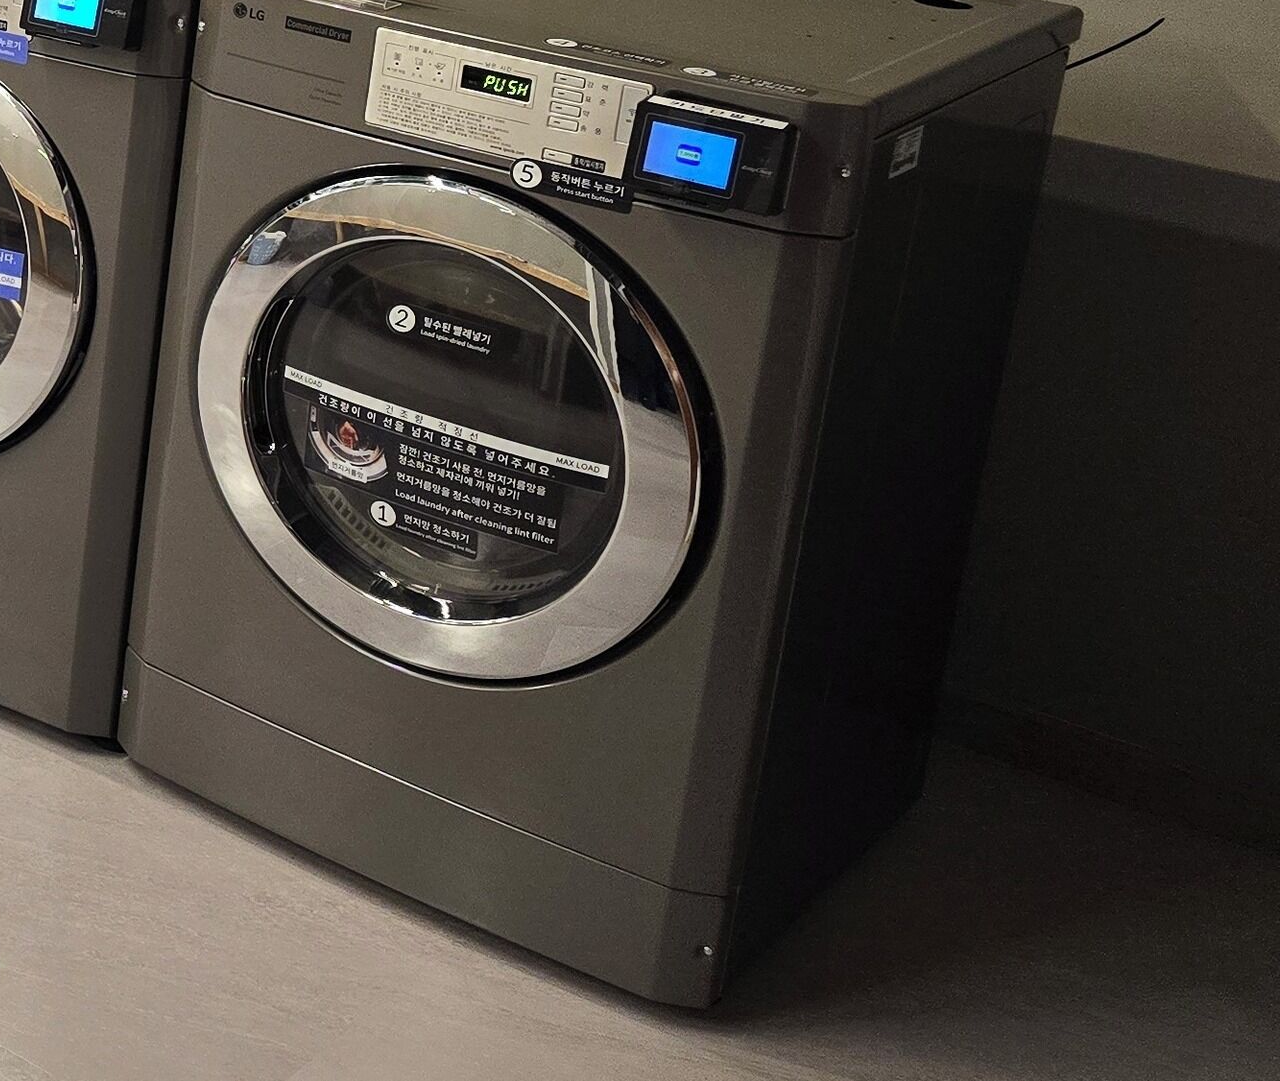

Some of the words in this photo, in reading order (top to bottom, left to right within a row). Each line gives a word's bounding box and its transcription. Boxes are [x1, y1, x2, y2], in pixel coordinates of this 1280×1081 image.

[249, 7, 265, 21] LG
[287, 19, 328, 36] Commercial
[329, 28, 350, 40] Dryer
[0, 38, 22, 51] 누르기
[483, 75, 529, 97] PUSH
[550, 171, 591, 189] 동작버튼
[594, 180, 625, 198] 누르기
[556, 185, 574, 196] Press
[575, 190, 590, 199] start
[591, 193, 614, 204] button
[420, 329, 435, 338] Load
[435, 333, 466, 347] spin-dried
[467, 341, 490, 356] laundry
[424, 317, 452, 333] 탈수된
[453, 325, 492, 345] 빨래넣기
[290, 371, 304, 382] MAX
[305, 375, 323, 388] LOAD
[318, 394, 361, 418] 건조량이
[367, 411, 377, 423] 이
[383, 418, 405, 433] 선을
[412, 426, 434, 442] 넘지
[441, 435, 478, 457] 않도록
[484, 449, 556, 479] 넣어주세요.
[385, 404, 424, 423] 건조량
[439, 422, 479, 442] 적정선
[398, 454, 434, 474] 청소하고
[435, 465, 474, 486] 제자리에
[475, 478, 495, 493] 끼워
[497, 486, 520, 501] 넣기!
[399, 443, 420, 459] 잠깐!
[422, 451, 450, 468] 건조기
[452, 461, 471, 475] 사용
[487, 471, 547, 497] 먼지거름망을
[556, 457, 574, 468] MAX
[576, 461, 600, 473] LOAD
[396, 471, 451, 498] 먼지거름망을
[452, 490, 491, 510] 청소해야
[492, 502, 523, 520] 건조가
[524, 512, 535, 523] 더
[395, 489, 416, 502] Load
[417, 495, 451, 515] laundry
[451, 506, 474, 521] after
[475, 516, 513, 536] cleaning
[514, 526, 530, 539] lint
[531, 532, 555, 545] filter
[403, 514, 431, 531] 먼지망
[432, 524, 470, 544] 청소하기
